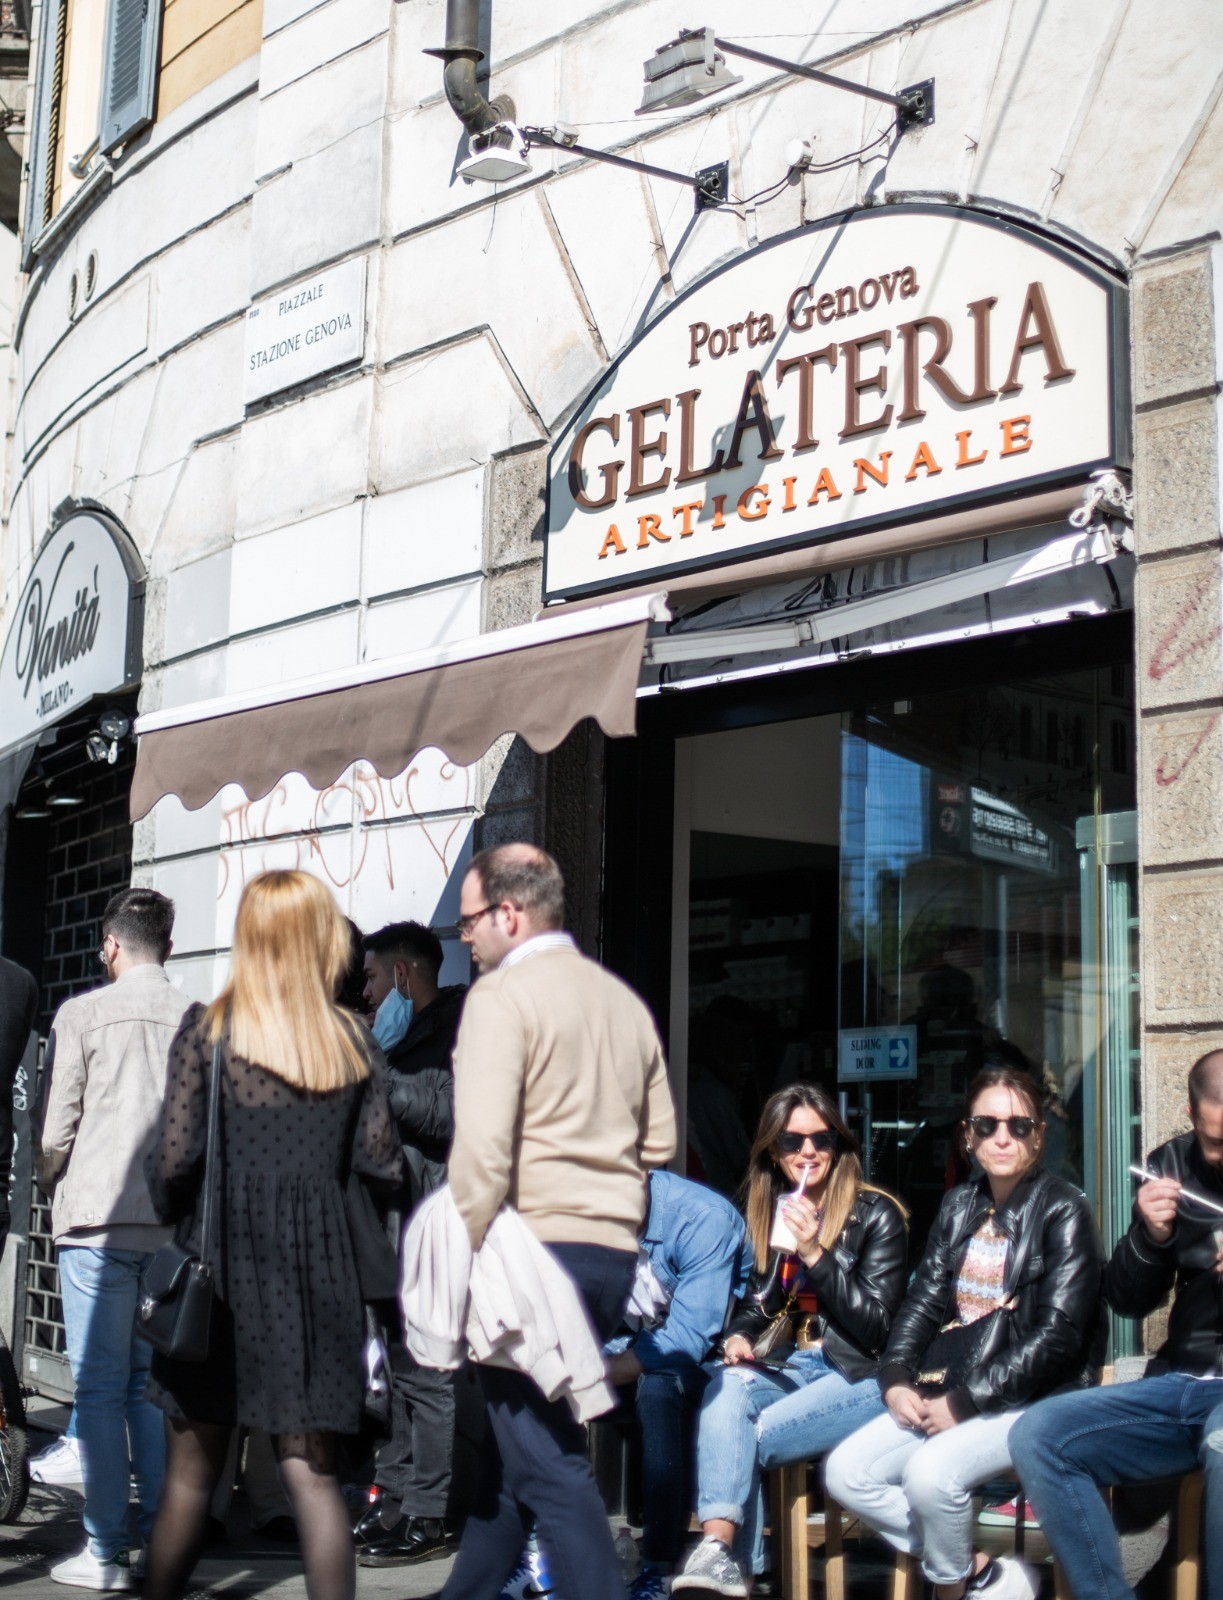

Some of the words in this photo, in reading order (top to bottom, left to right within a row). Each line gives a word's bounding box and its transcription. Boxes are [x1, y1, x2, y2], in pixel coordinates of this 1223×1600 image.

[250, 334, 301, 370] STAZIONE
[305, 313, 352, 345] GENOVA
[279, 284, 324, 316] PIAZZALE
[688, 311, 776, 367] Porta
[787, 266, 920, 332] Genova
[568, 281, 1077, 510] GELATERIA
[598, 415, 1033, 559] ARTIGIANALE
